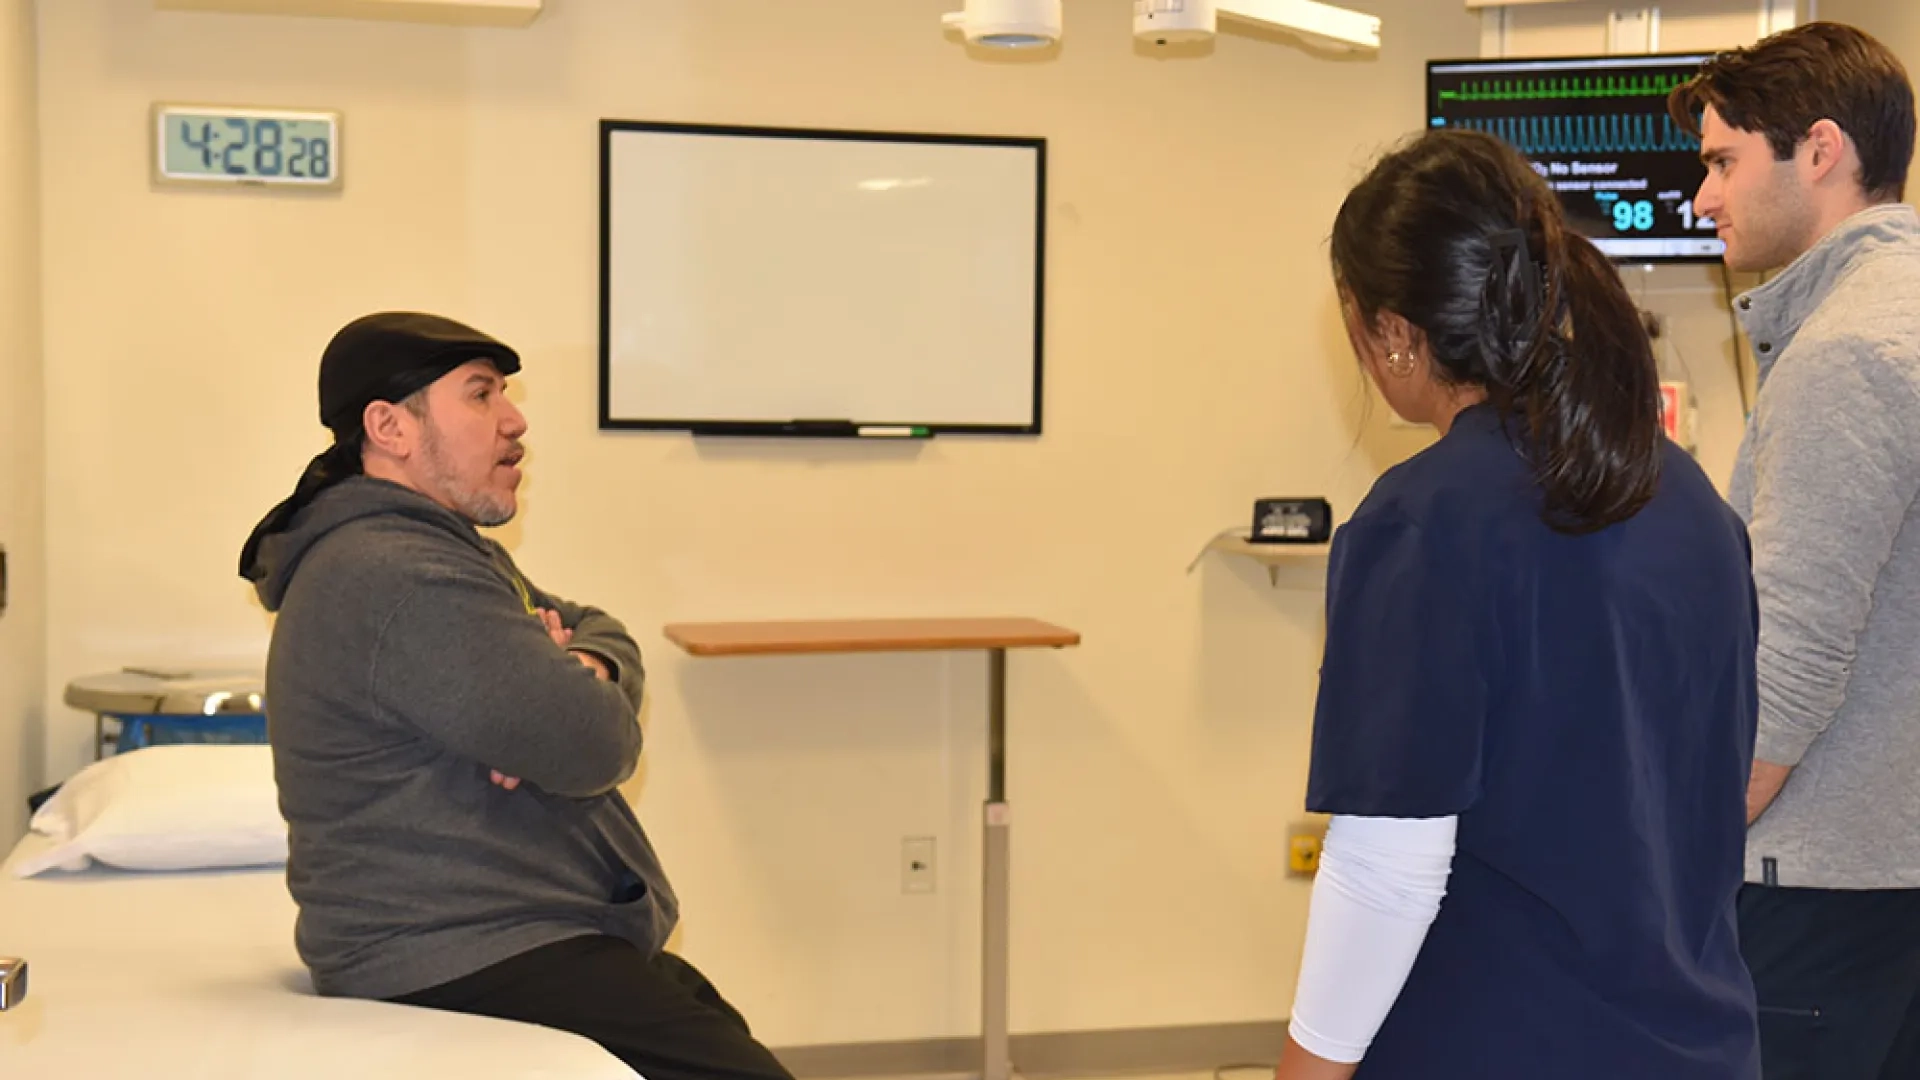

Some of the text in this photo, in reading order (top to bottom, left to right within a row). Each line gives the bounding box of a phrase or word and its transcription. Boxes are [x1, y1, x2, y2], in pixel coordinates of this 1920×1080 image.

[181, 117, 329, 178] 4:28 28
[1550, 162, 1569, 175] No
[1572, 161, 1618, 175] Sensor
[1613, 200, 1654, 230] 98
